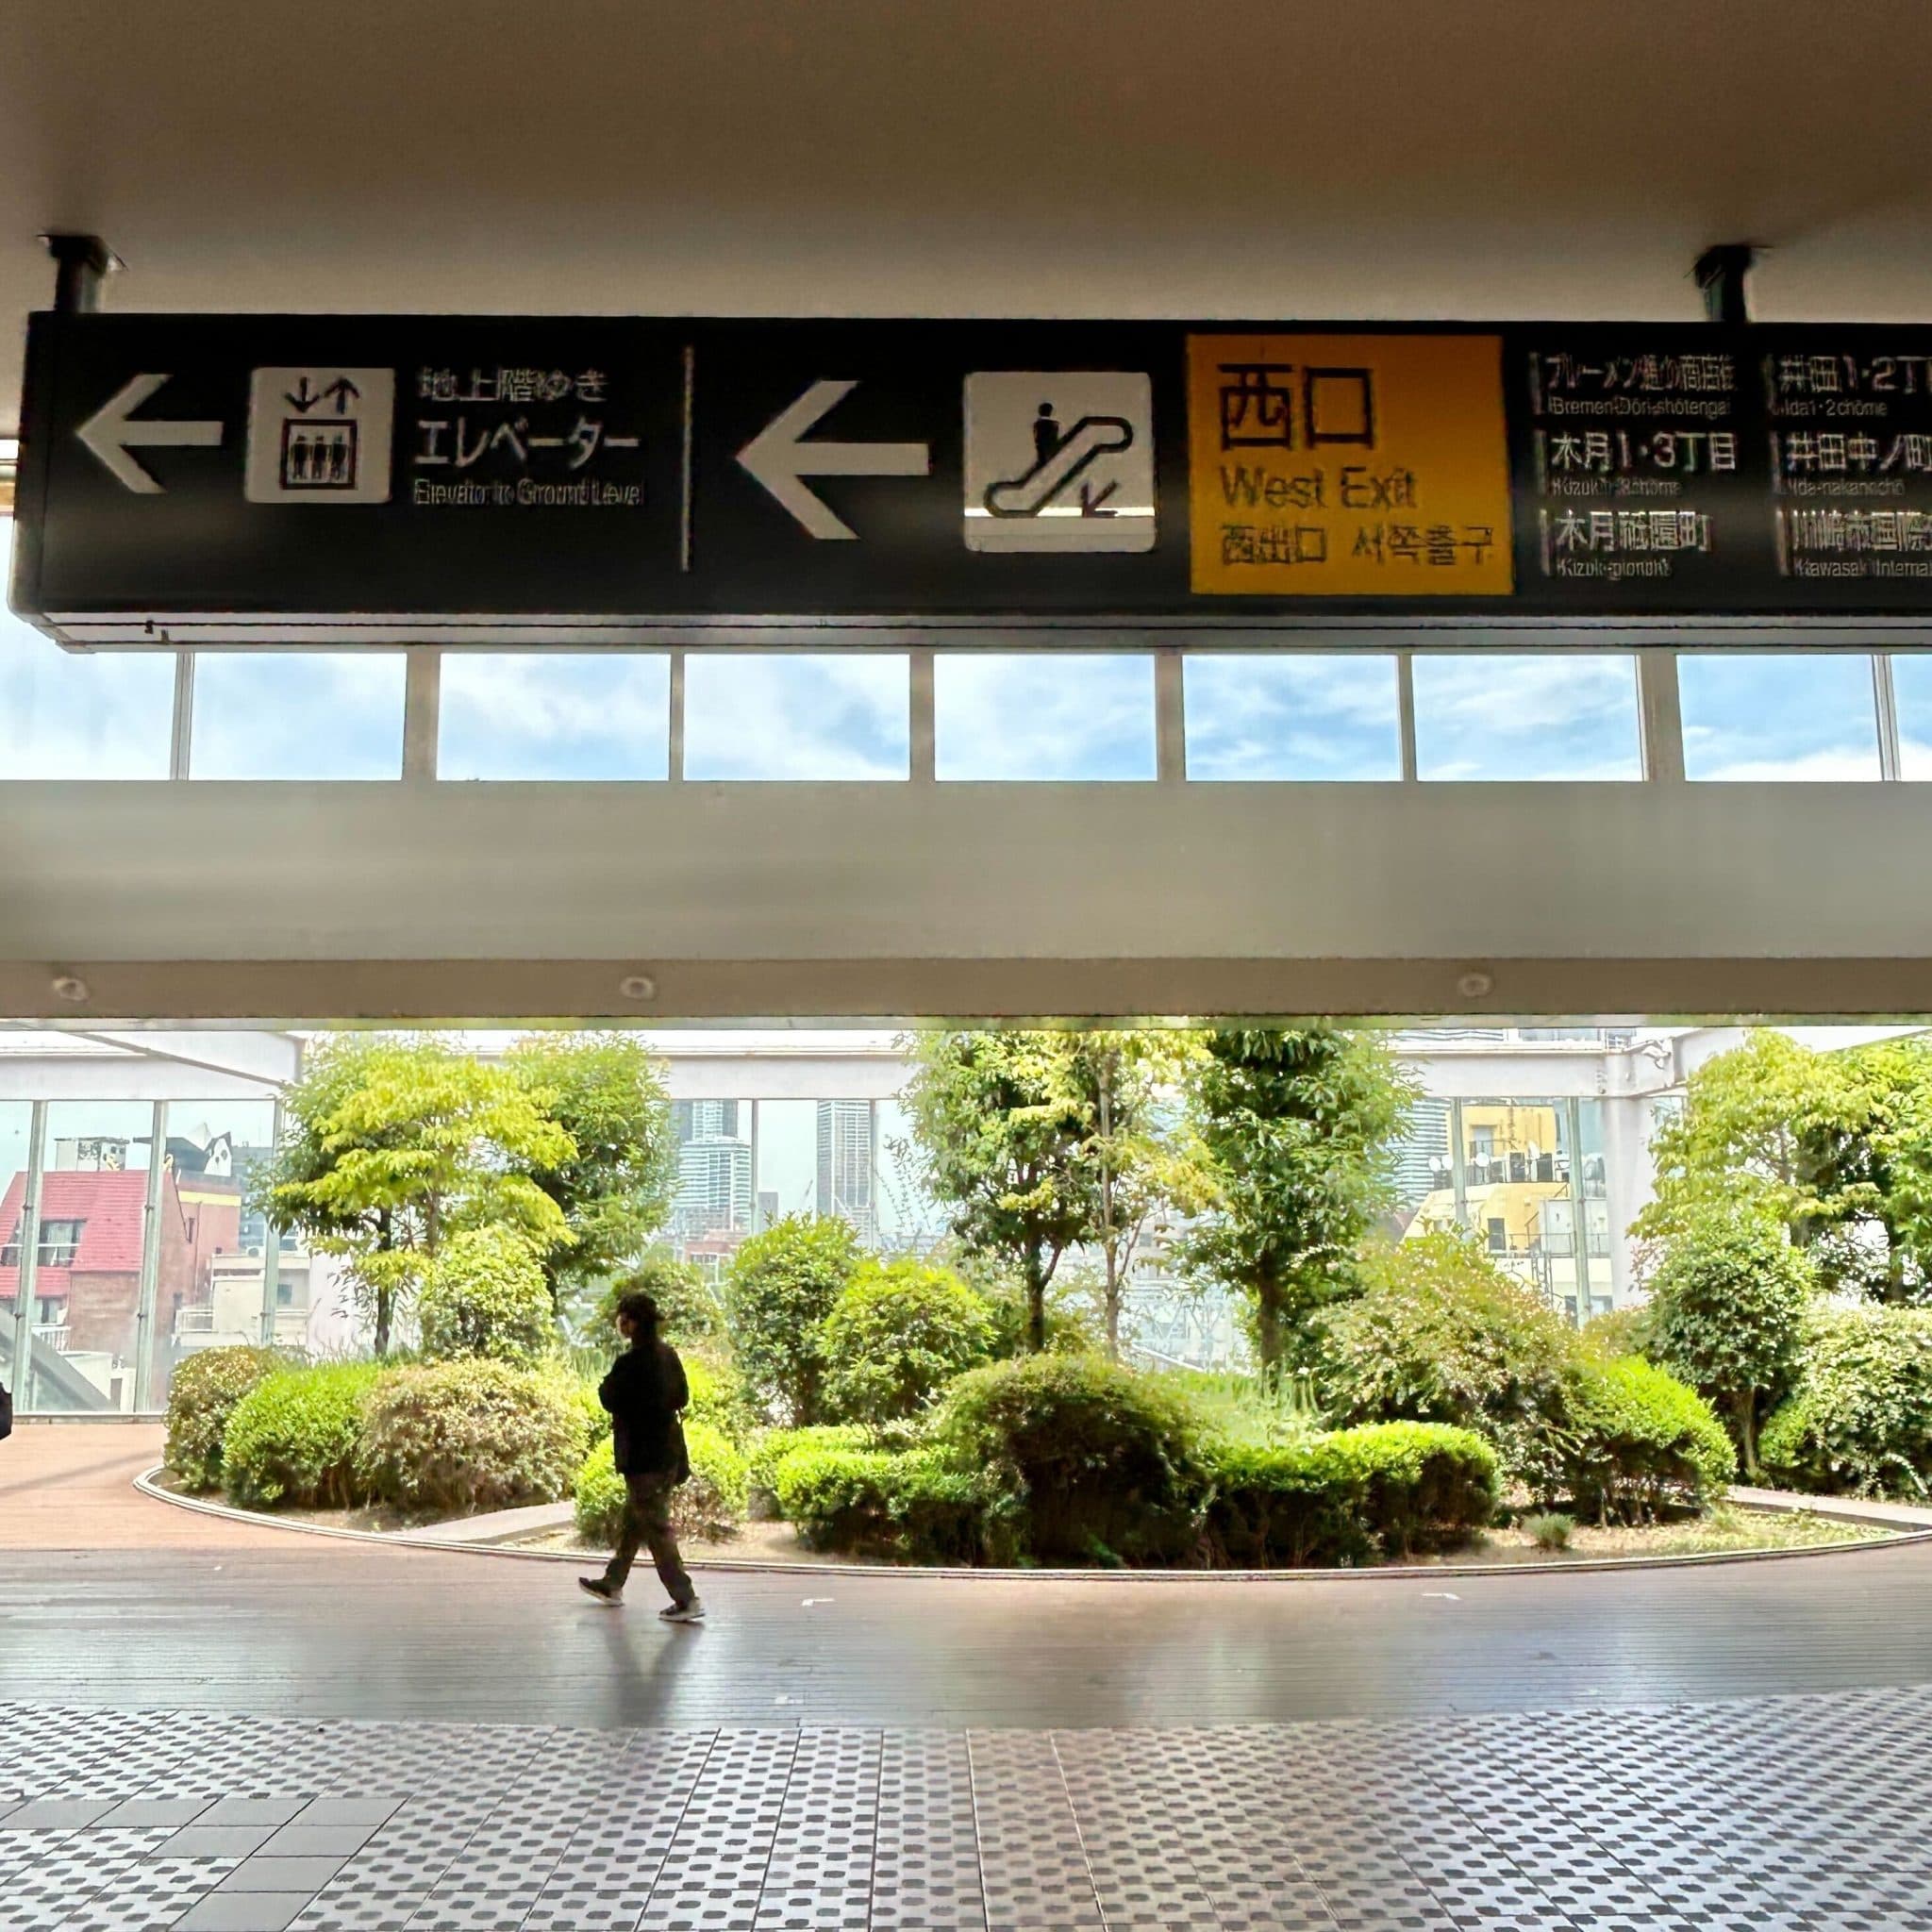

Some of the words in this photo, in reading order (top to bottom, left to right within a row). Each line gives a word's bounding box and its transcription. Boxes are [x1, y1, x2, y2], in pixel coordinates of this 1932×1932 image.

[1217, 362, 1374, 451] 西口
[414, 415, 641, 470] エレベーター
[1220, 465, 1327, 509] West
[1340, 465, 1418, 509] Exit
